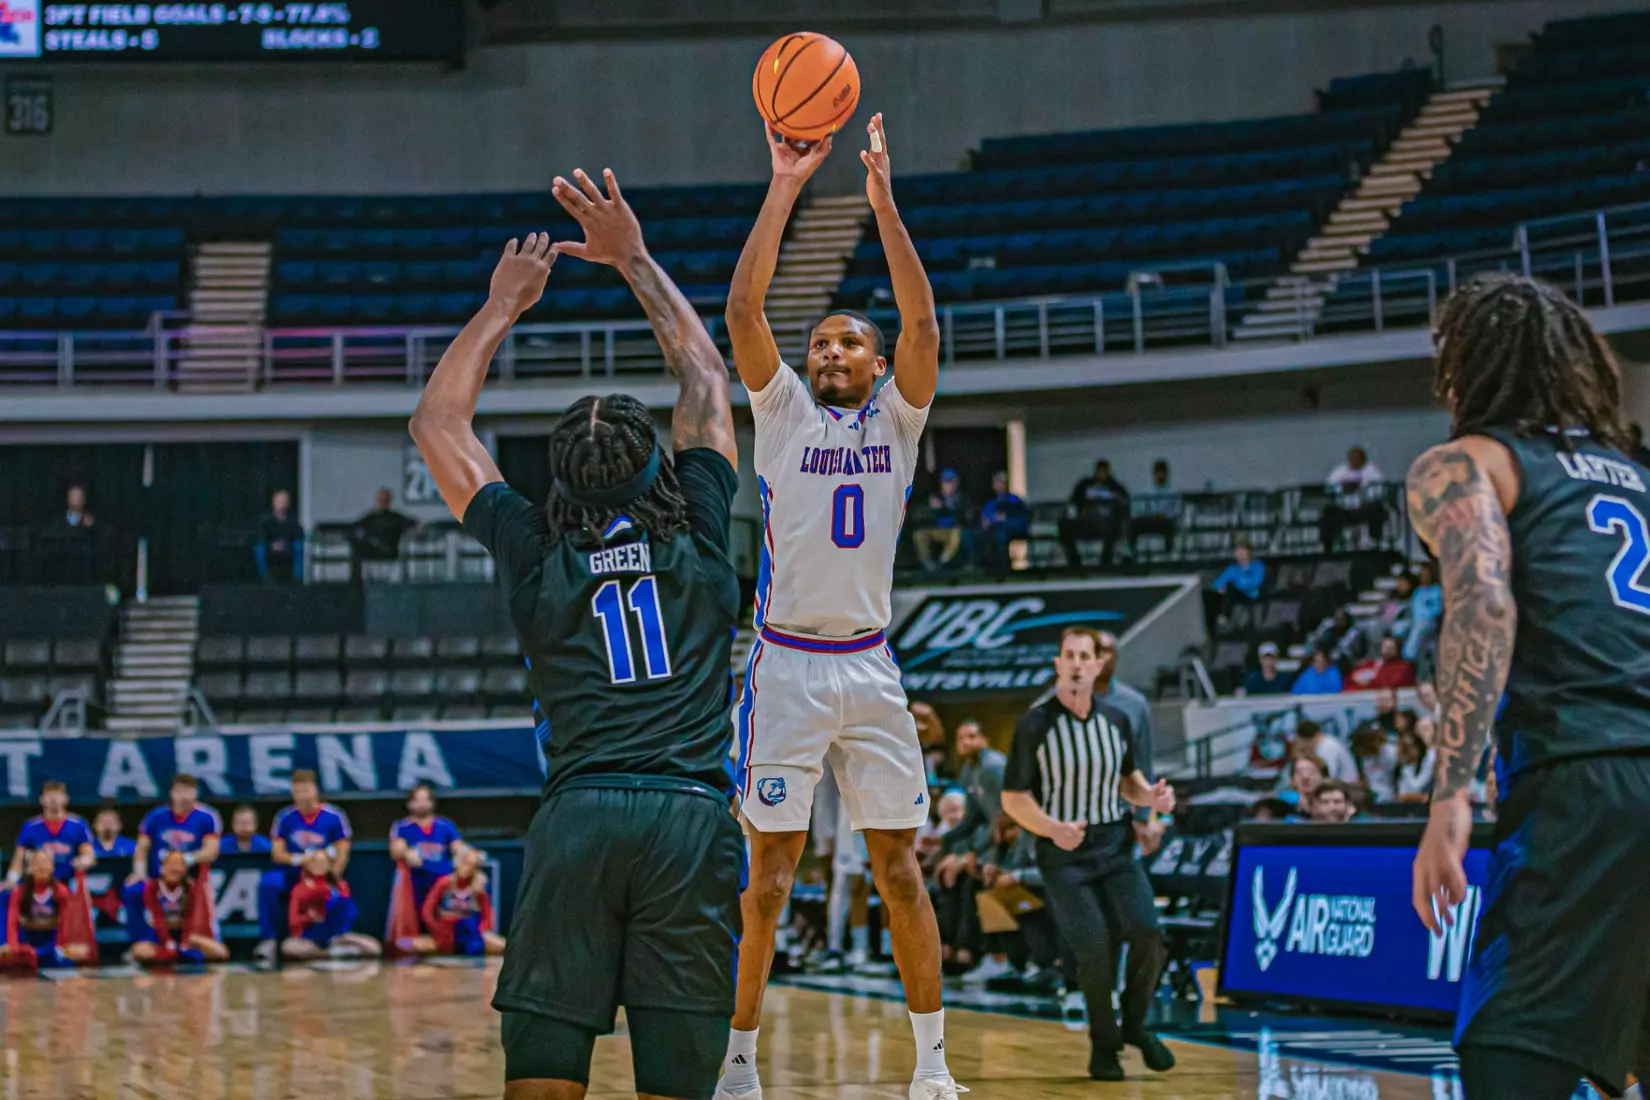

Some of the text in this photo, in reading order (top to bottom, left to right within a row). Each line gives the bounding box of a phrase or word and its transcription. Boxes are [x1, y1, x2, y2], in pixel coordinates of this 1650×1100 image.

[88, 5, 150, 25] FIELD
[153, 4, 225, 25] GOALS
[262, 28, 348, 49] BLOCKS
[861, 445, 891, 474] TECH
[831, 484, 865, 549] 0
[589, 542, 651, 574] GREEN
[591, 574, 672, 684] 11
[900, 598, 1046, 650] VBC
[98, 730, 454, 798] ARENA
[1285, 894, 1330, 954] AIR
[1326, 922, 1375, 957] GUARD
